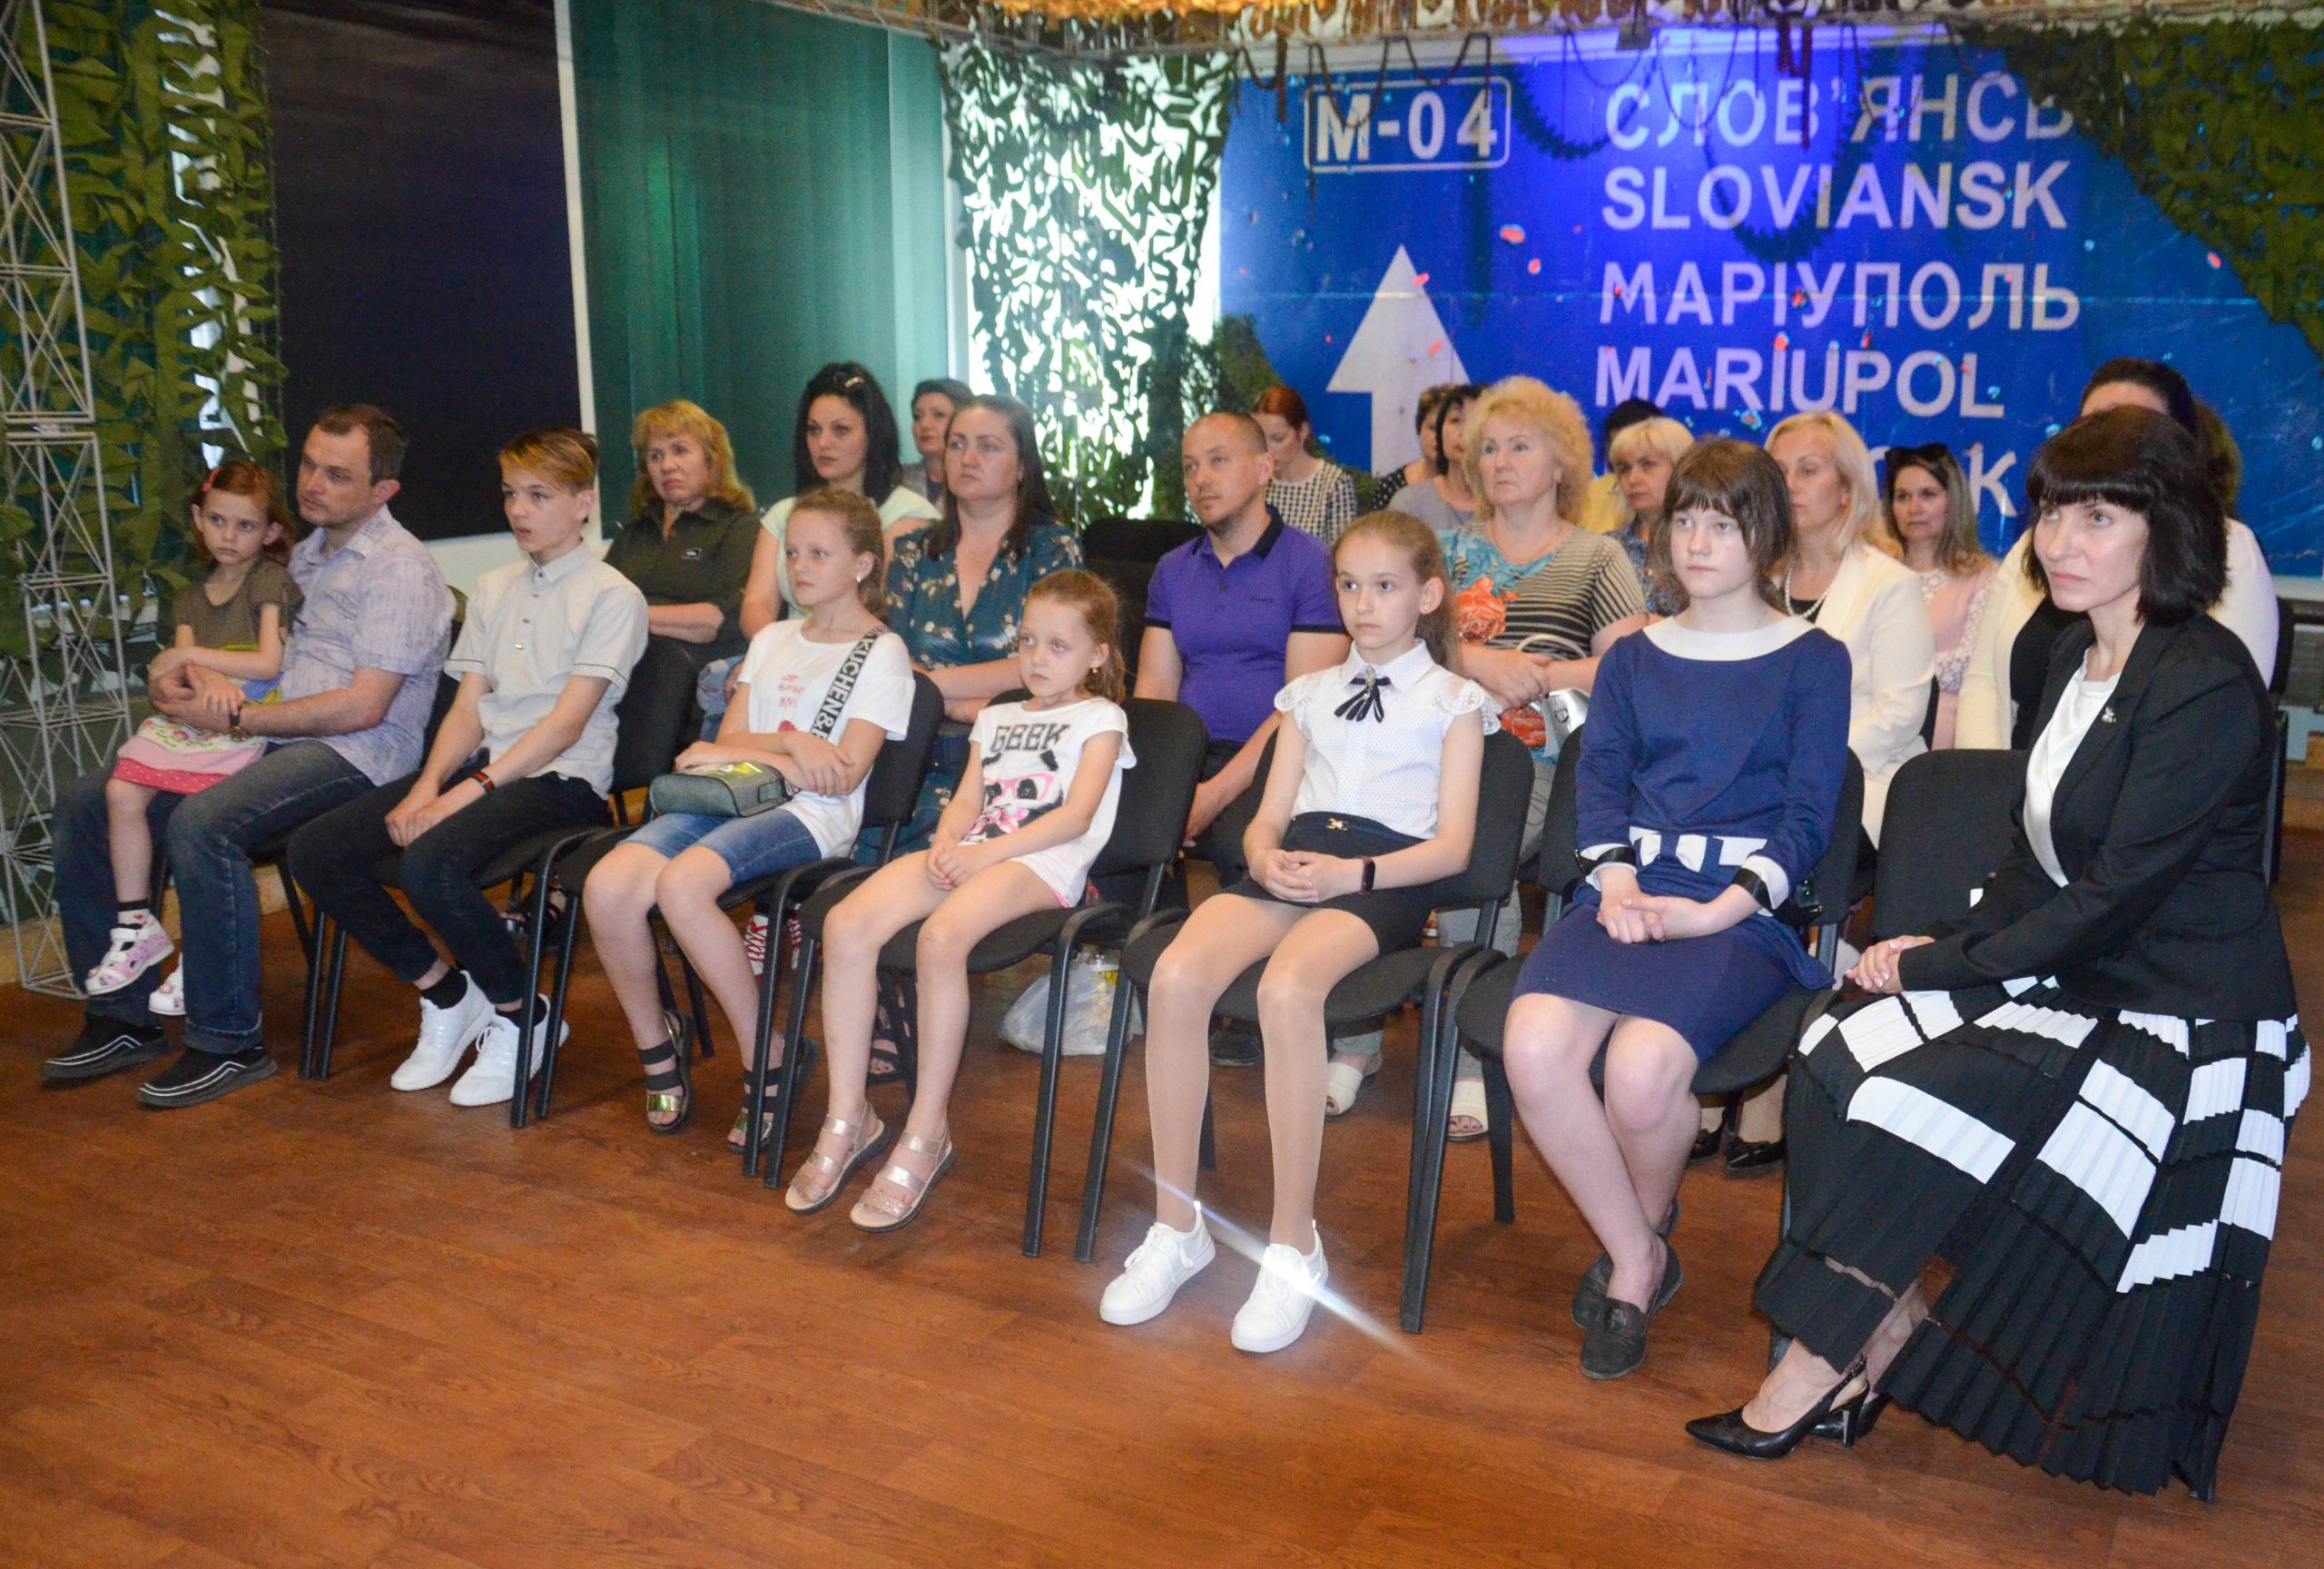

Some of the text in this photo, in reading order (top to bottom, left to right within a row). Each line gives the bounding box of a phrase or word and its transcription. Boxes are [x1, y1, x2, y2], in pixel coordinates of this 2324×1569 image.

[1316, 89, 1498, 162] M-04
[1601, 160, 2071, 230] SLOVIANSK
[1600, 261, 2081, 331] МАРІУПОЛЬ
[1595, 345, 2004, 419] MARIUPOL
[990, 723, 1071, 753] GEEK
